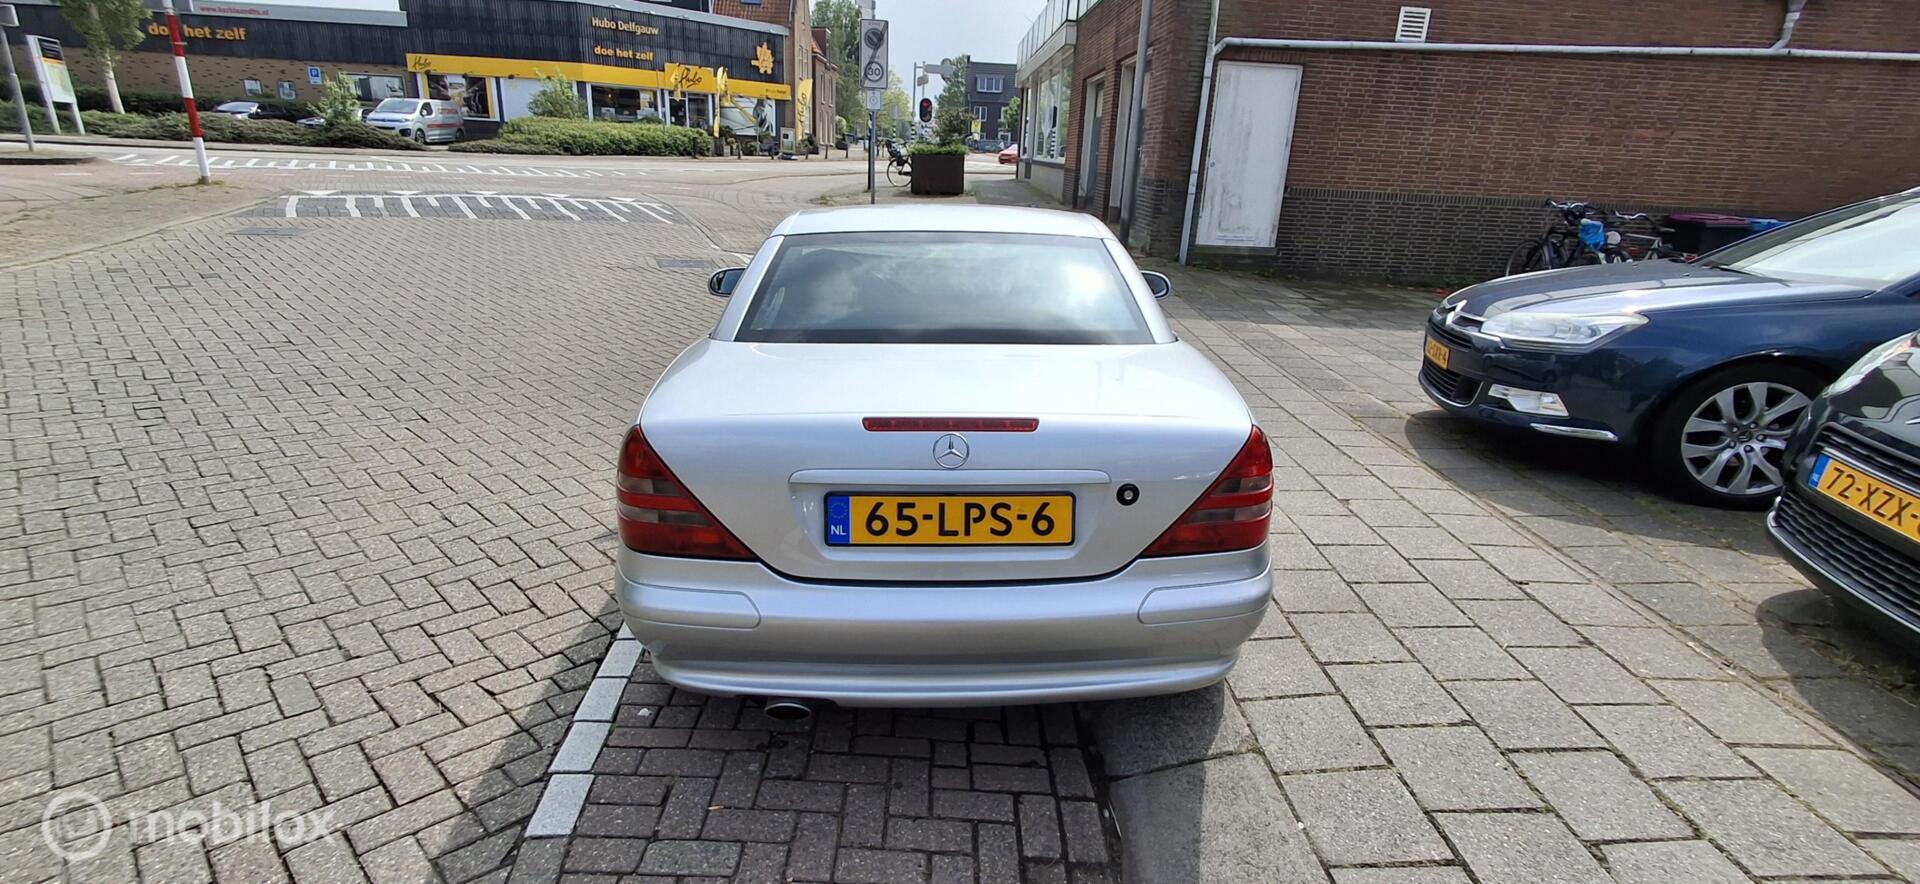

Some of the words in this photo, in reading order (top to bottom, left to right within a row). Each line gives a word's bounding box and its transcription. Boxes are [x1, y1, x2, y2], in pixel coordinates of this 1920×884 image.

[148, 23, 171, 36] do
[183, 24, 212, 38] het
[215, 27, 247, 40] zelf
[592, 17, 616, 30] Hubo
[618, 21, 659, 35] Delfgauw
[594, 46, 614, 56] doe
[616, 48, 633, 59] het
[635, 51, 654, 61] zelf
[679, 67, 703, 89] Hubo
[867, 67, 881, 76] 30
[1826, 466, 1920, 537] 72-XZX-
[865, 502, 1055, 537] 65-LPS-6
[831, 525, 847, 535] NL
